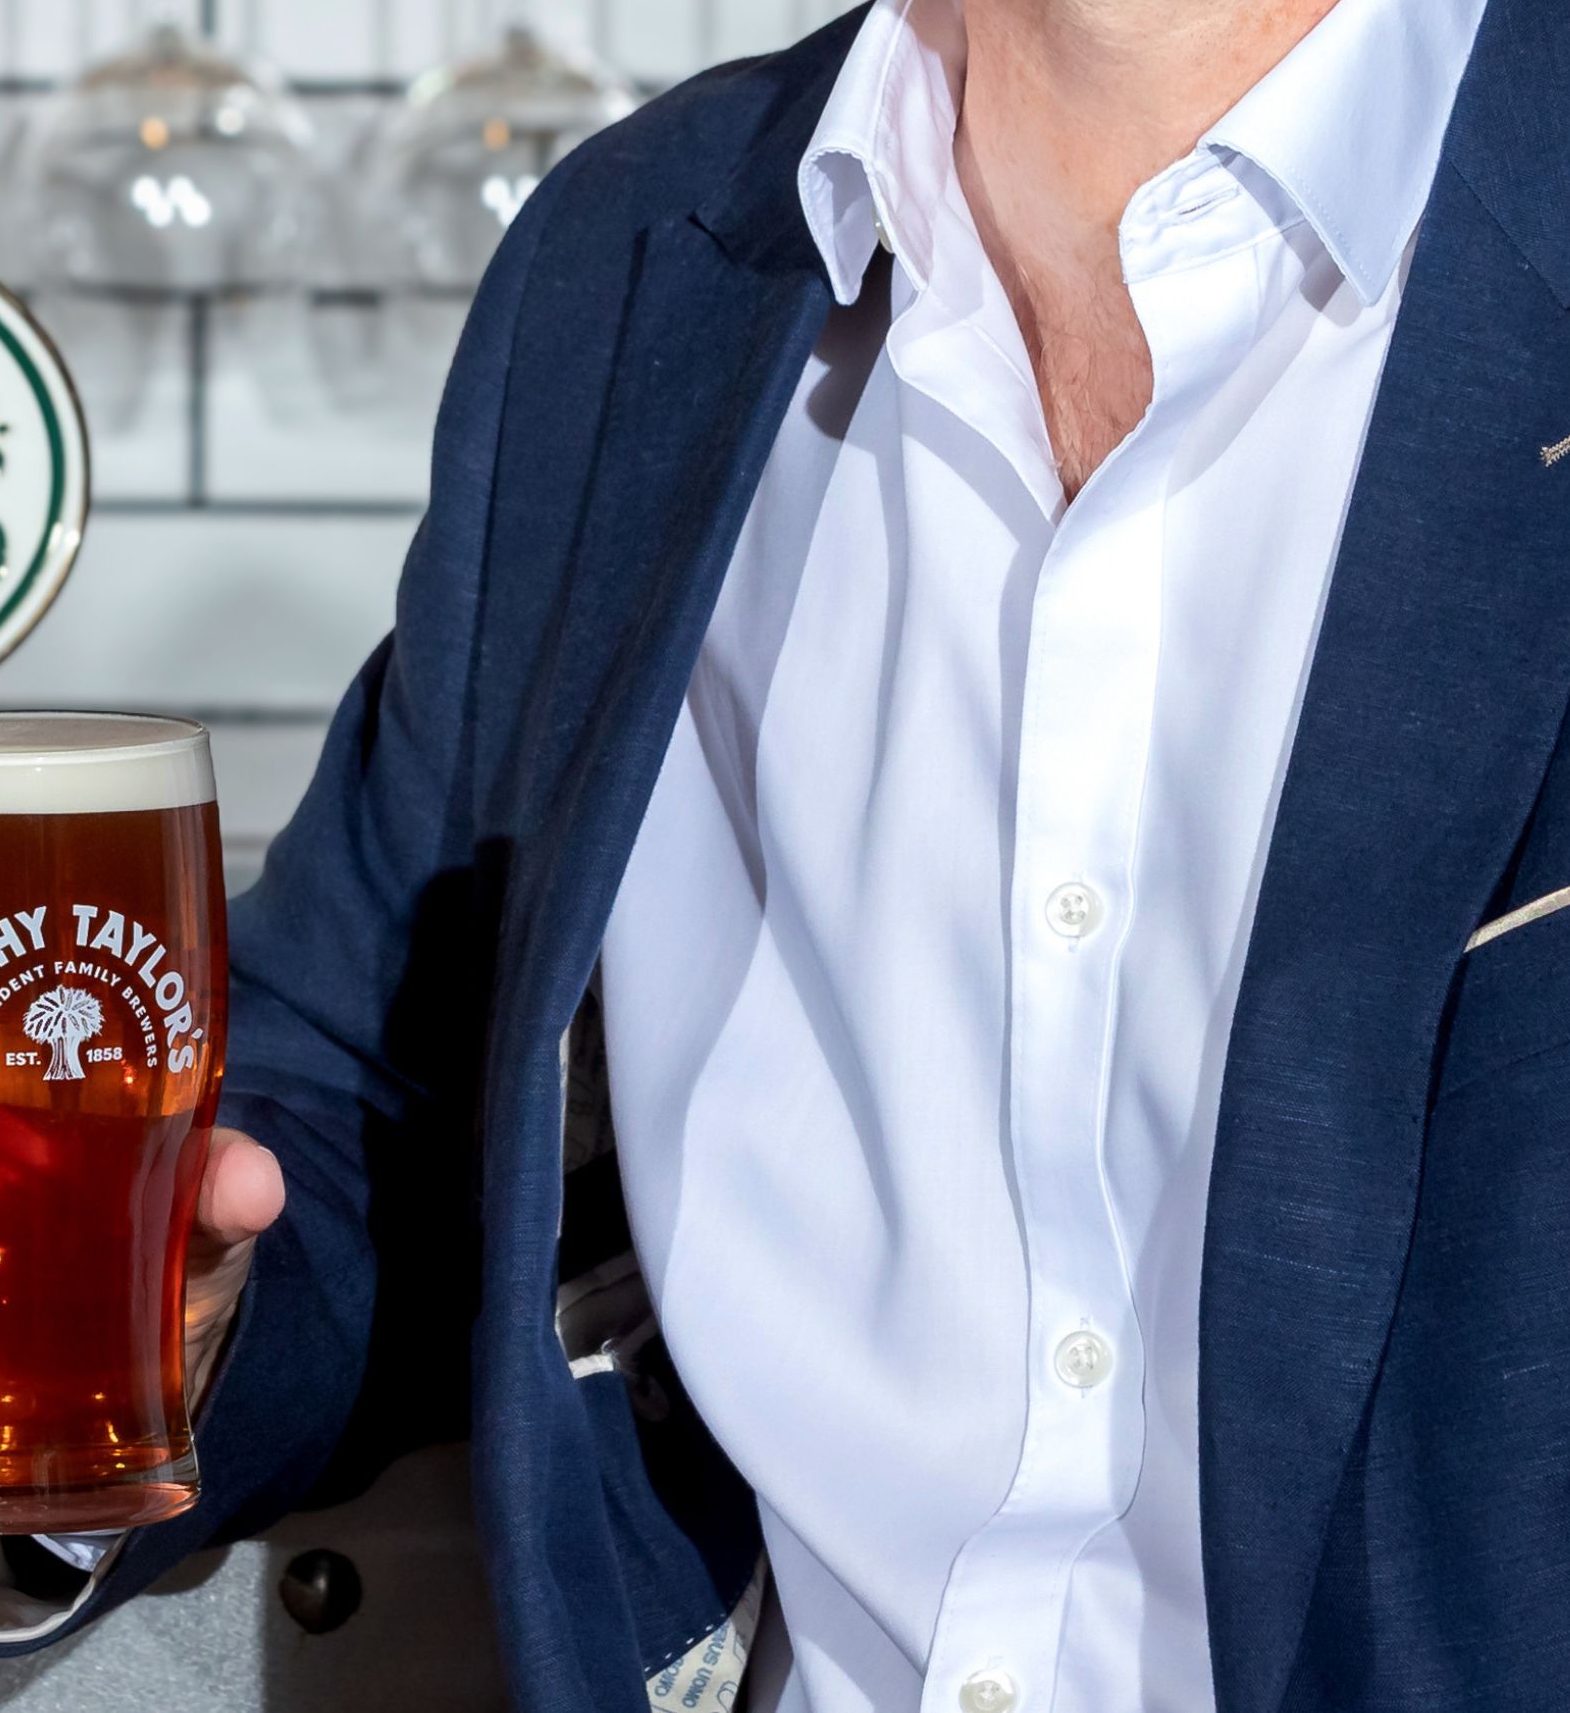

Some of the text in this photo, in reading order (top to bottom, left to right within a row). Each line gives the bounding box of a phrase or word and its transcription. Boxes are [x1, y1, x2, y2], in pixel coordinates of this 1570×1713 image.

[54, 961, 122, 987] FAMILY
[122, 986, 158, 1069] BREWERS
[73, 904, 204, 1074] TAYLOR'S
[6, 1046, 123, 1066] EST. 1858
[681, 1667, 714, 1708] UOMO
